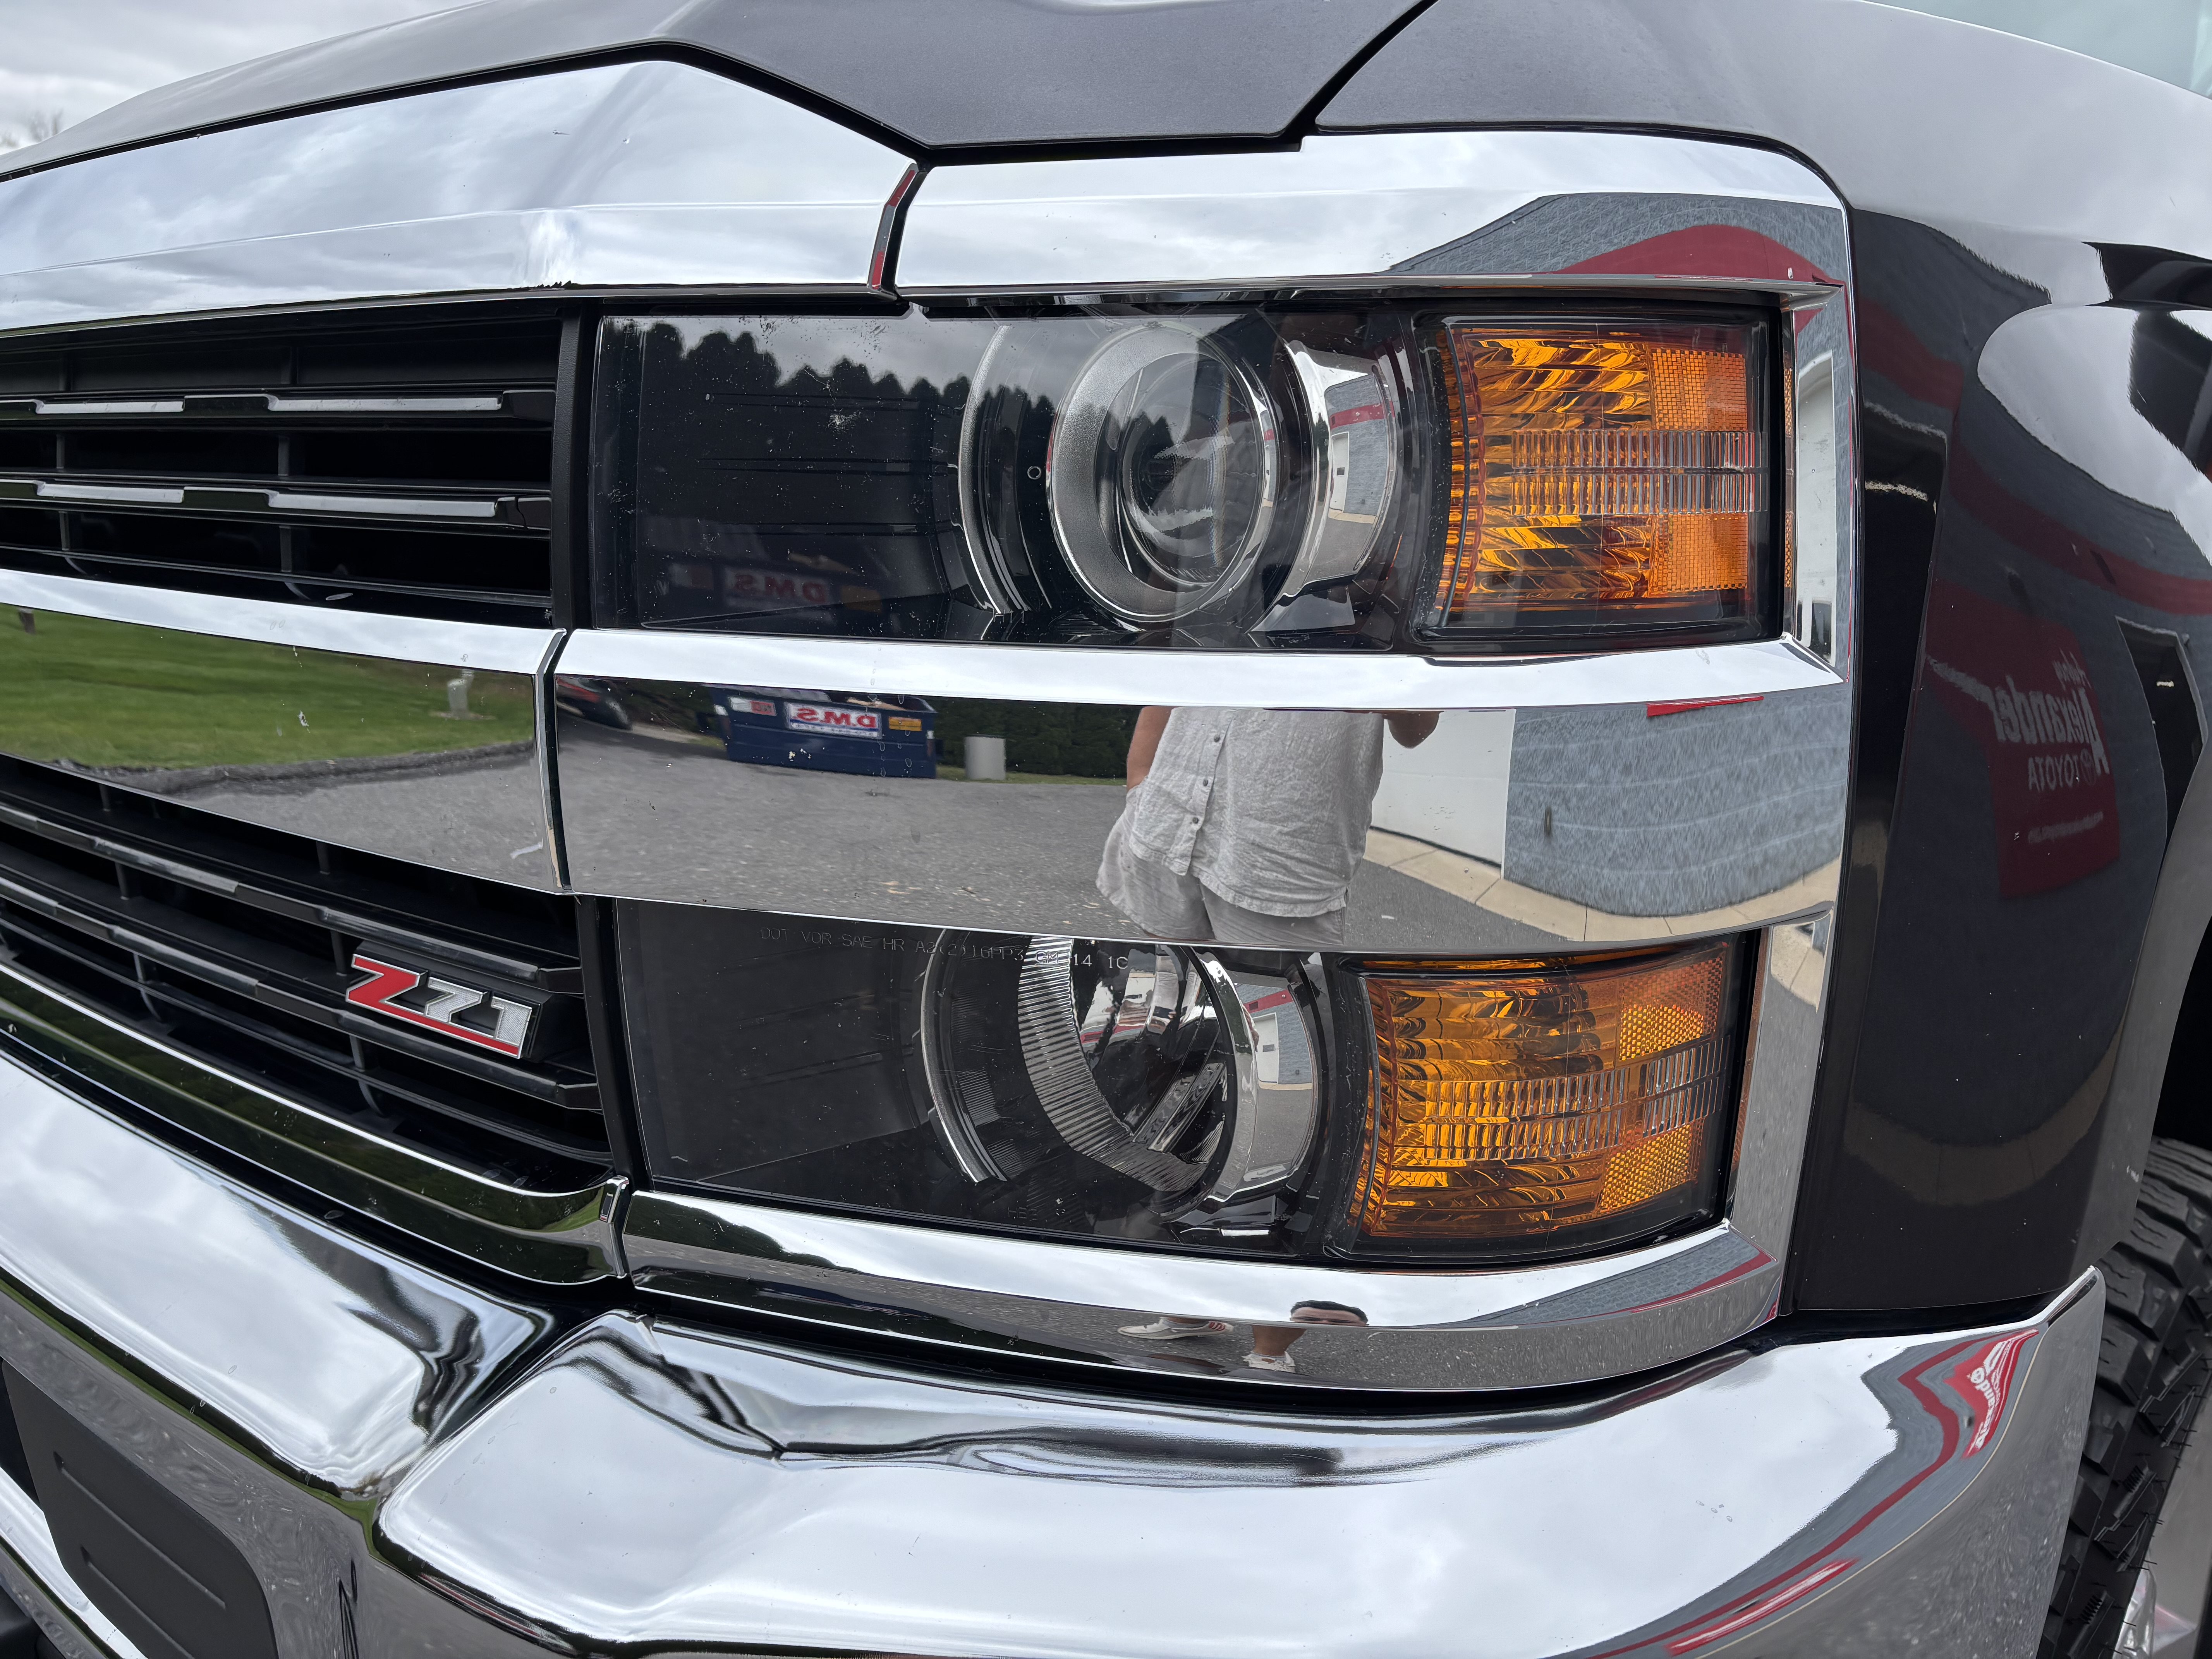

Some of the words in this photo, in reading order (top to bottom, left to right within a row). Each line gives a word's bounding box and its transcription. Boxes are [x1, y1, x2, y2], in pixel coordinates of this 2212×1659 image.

[761, 927, 790, 941] DOT
[801, 930, 832, 945] VOR
[841, 934, 873, 948] SAE
[883, 938, 905, 951] HR
[1035, 950, 1060, 964] GM
[1073, 953, 1092, 967] 14
[345, 953, 532, 1059] Z71
